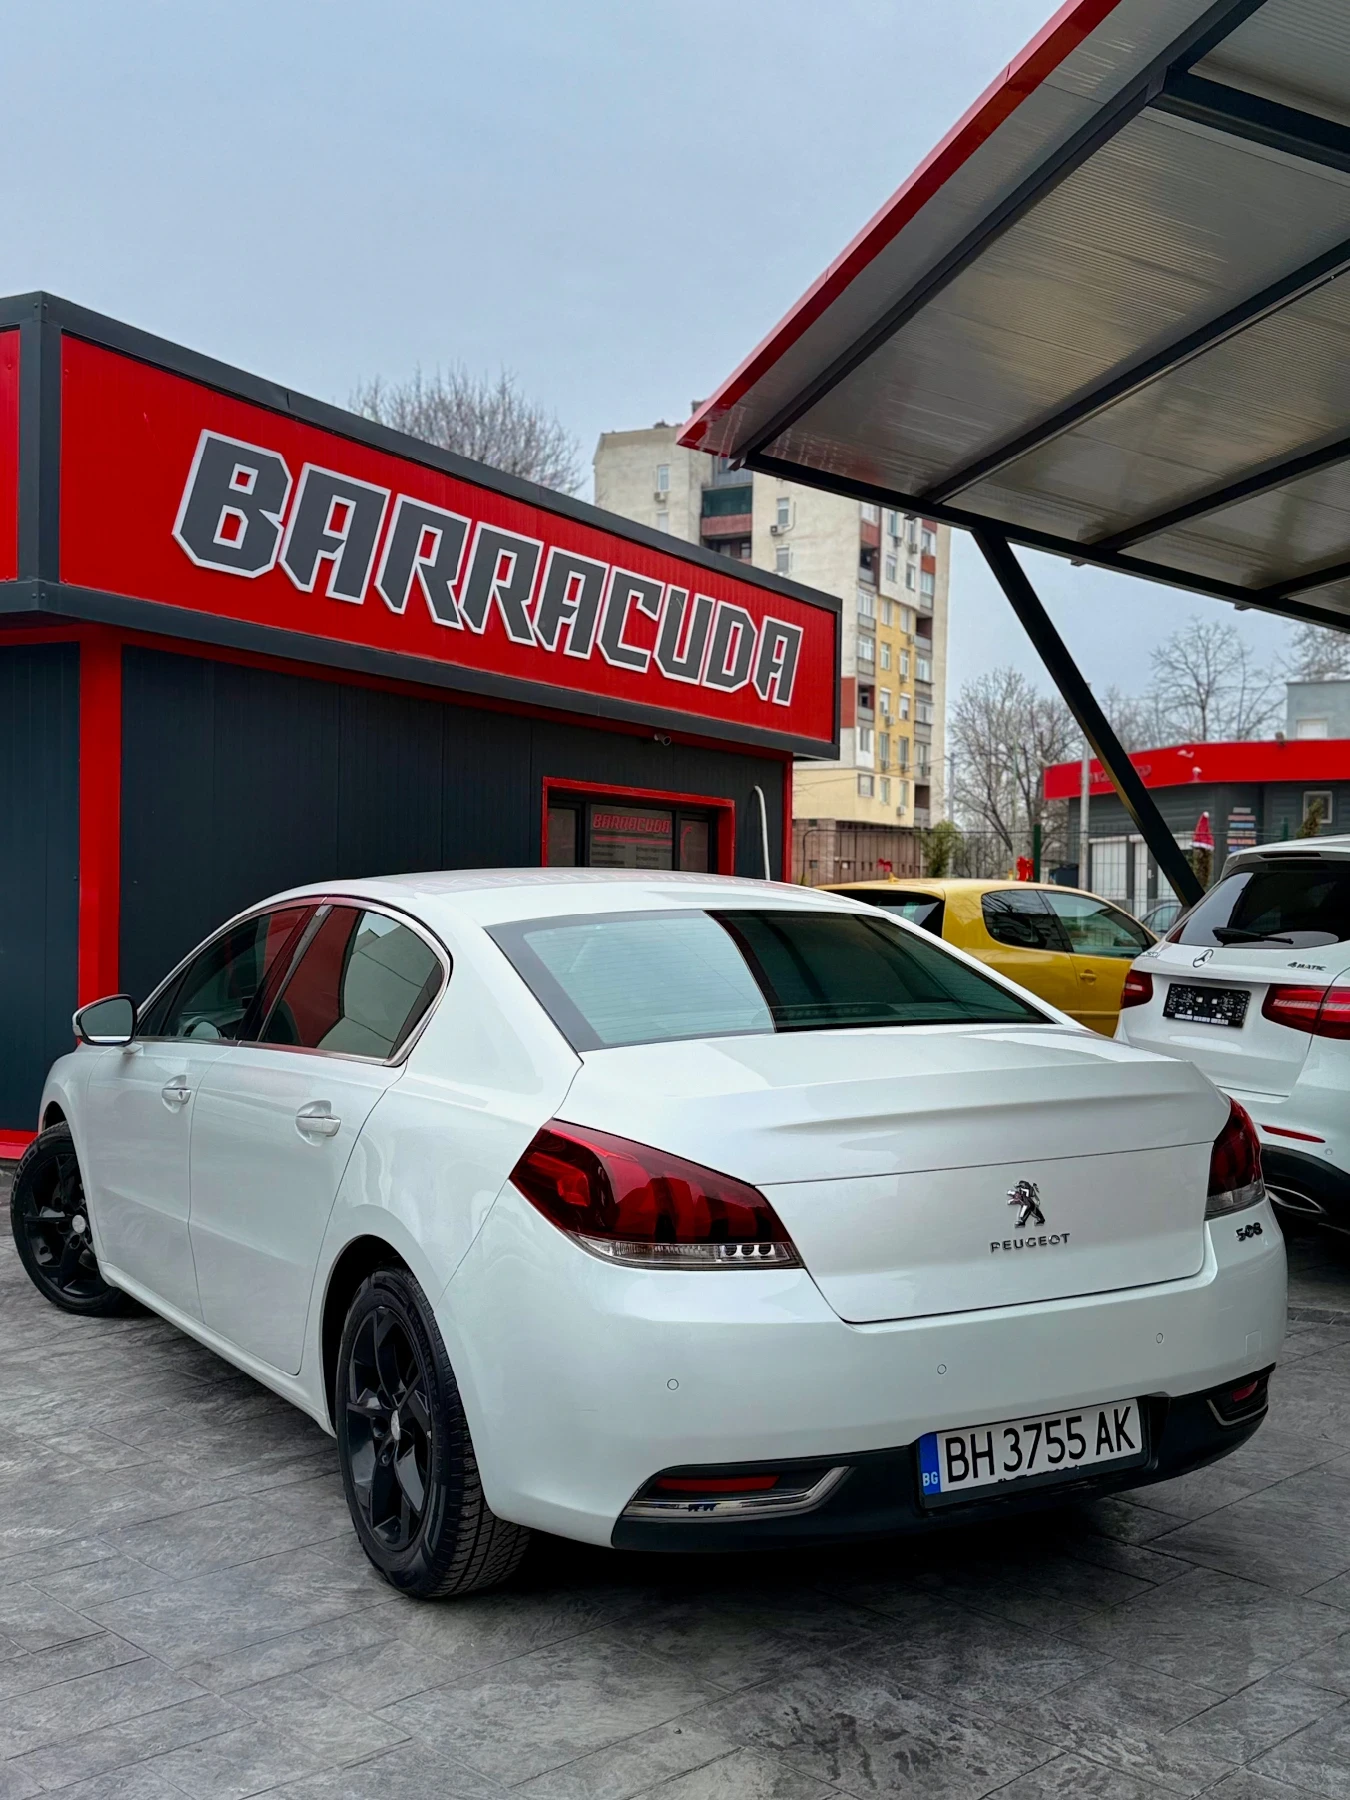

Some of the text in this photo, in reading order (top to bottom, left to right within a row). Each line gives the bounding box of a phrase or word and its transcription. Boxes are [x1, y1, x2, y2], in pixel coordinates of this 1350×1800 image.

[171, 428, 804, 707] BARRACUDA
[593, 813, 671, 834] BARRACUDA
[1235, 1222, 1263, 1242] 508
[990, 1233, 1070, 1253] PEUGEOT
[945, 1406, 1136, 1483] BH 3755 AK
[921, 1471, 939, 1487] BG
